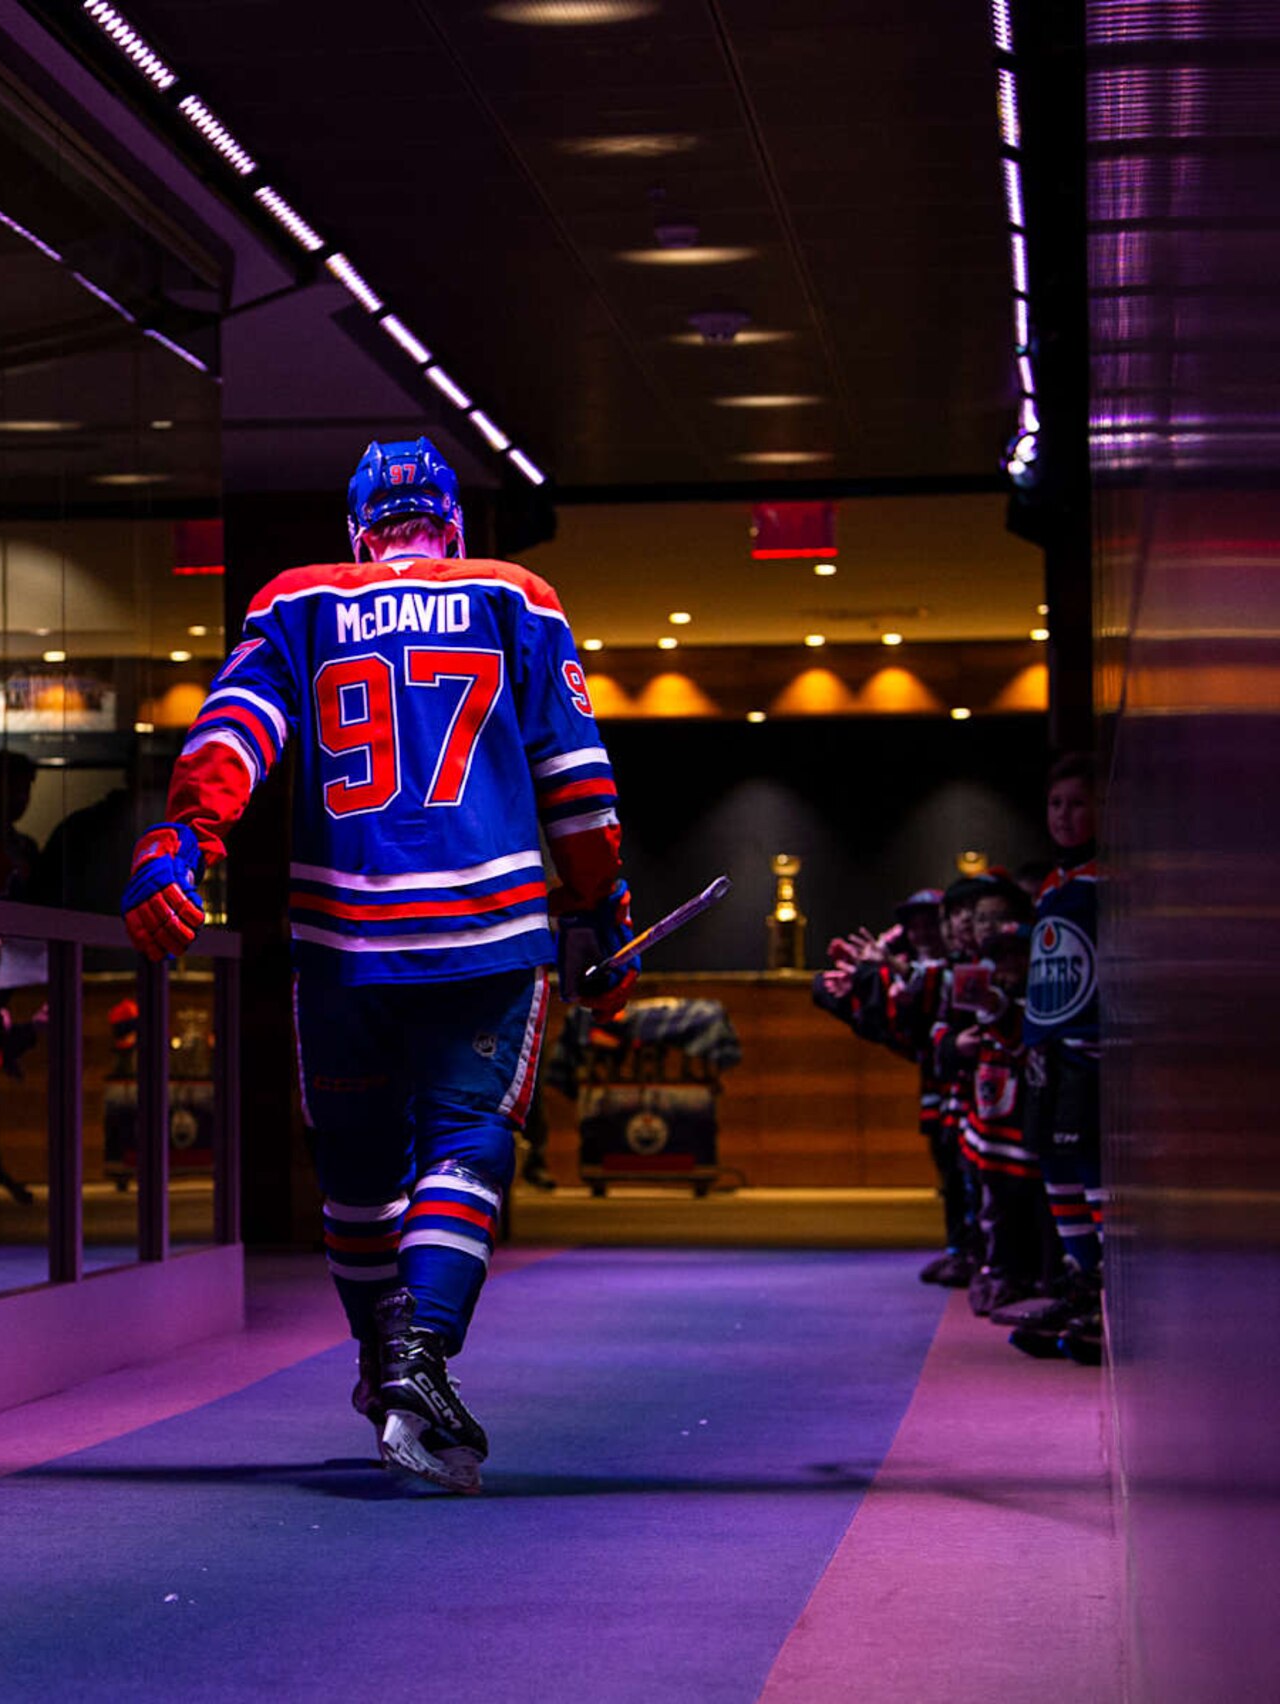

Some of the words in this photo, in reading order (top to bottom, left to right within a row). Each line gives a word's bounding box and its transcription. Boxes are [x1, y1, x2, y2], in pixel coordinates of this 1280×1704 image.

[389, 464, 416, 485] 97
[336, 593, 471, 643] McDAVID
[561, 660, 595, 718] 9
[313, 646, 505, 819] 97
[414, 1371, 464, 1431] CCM
